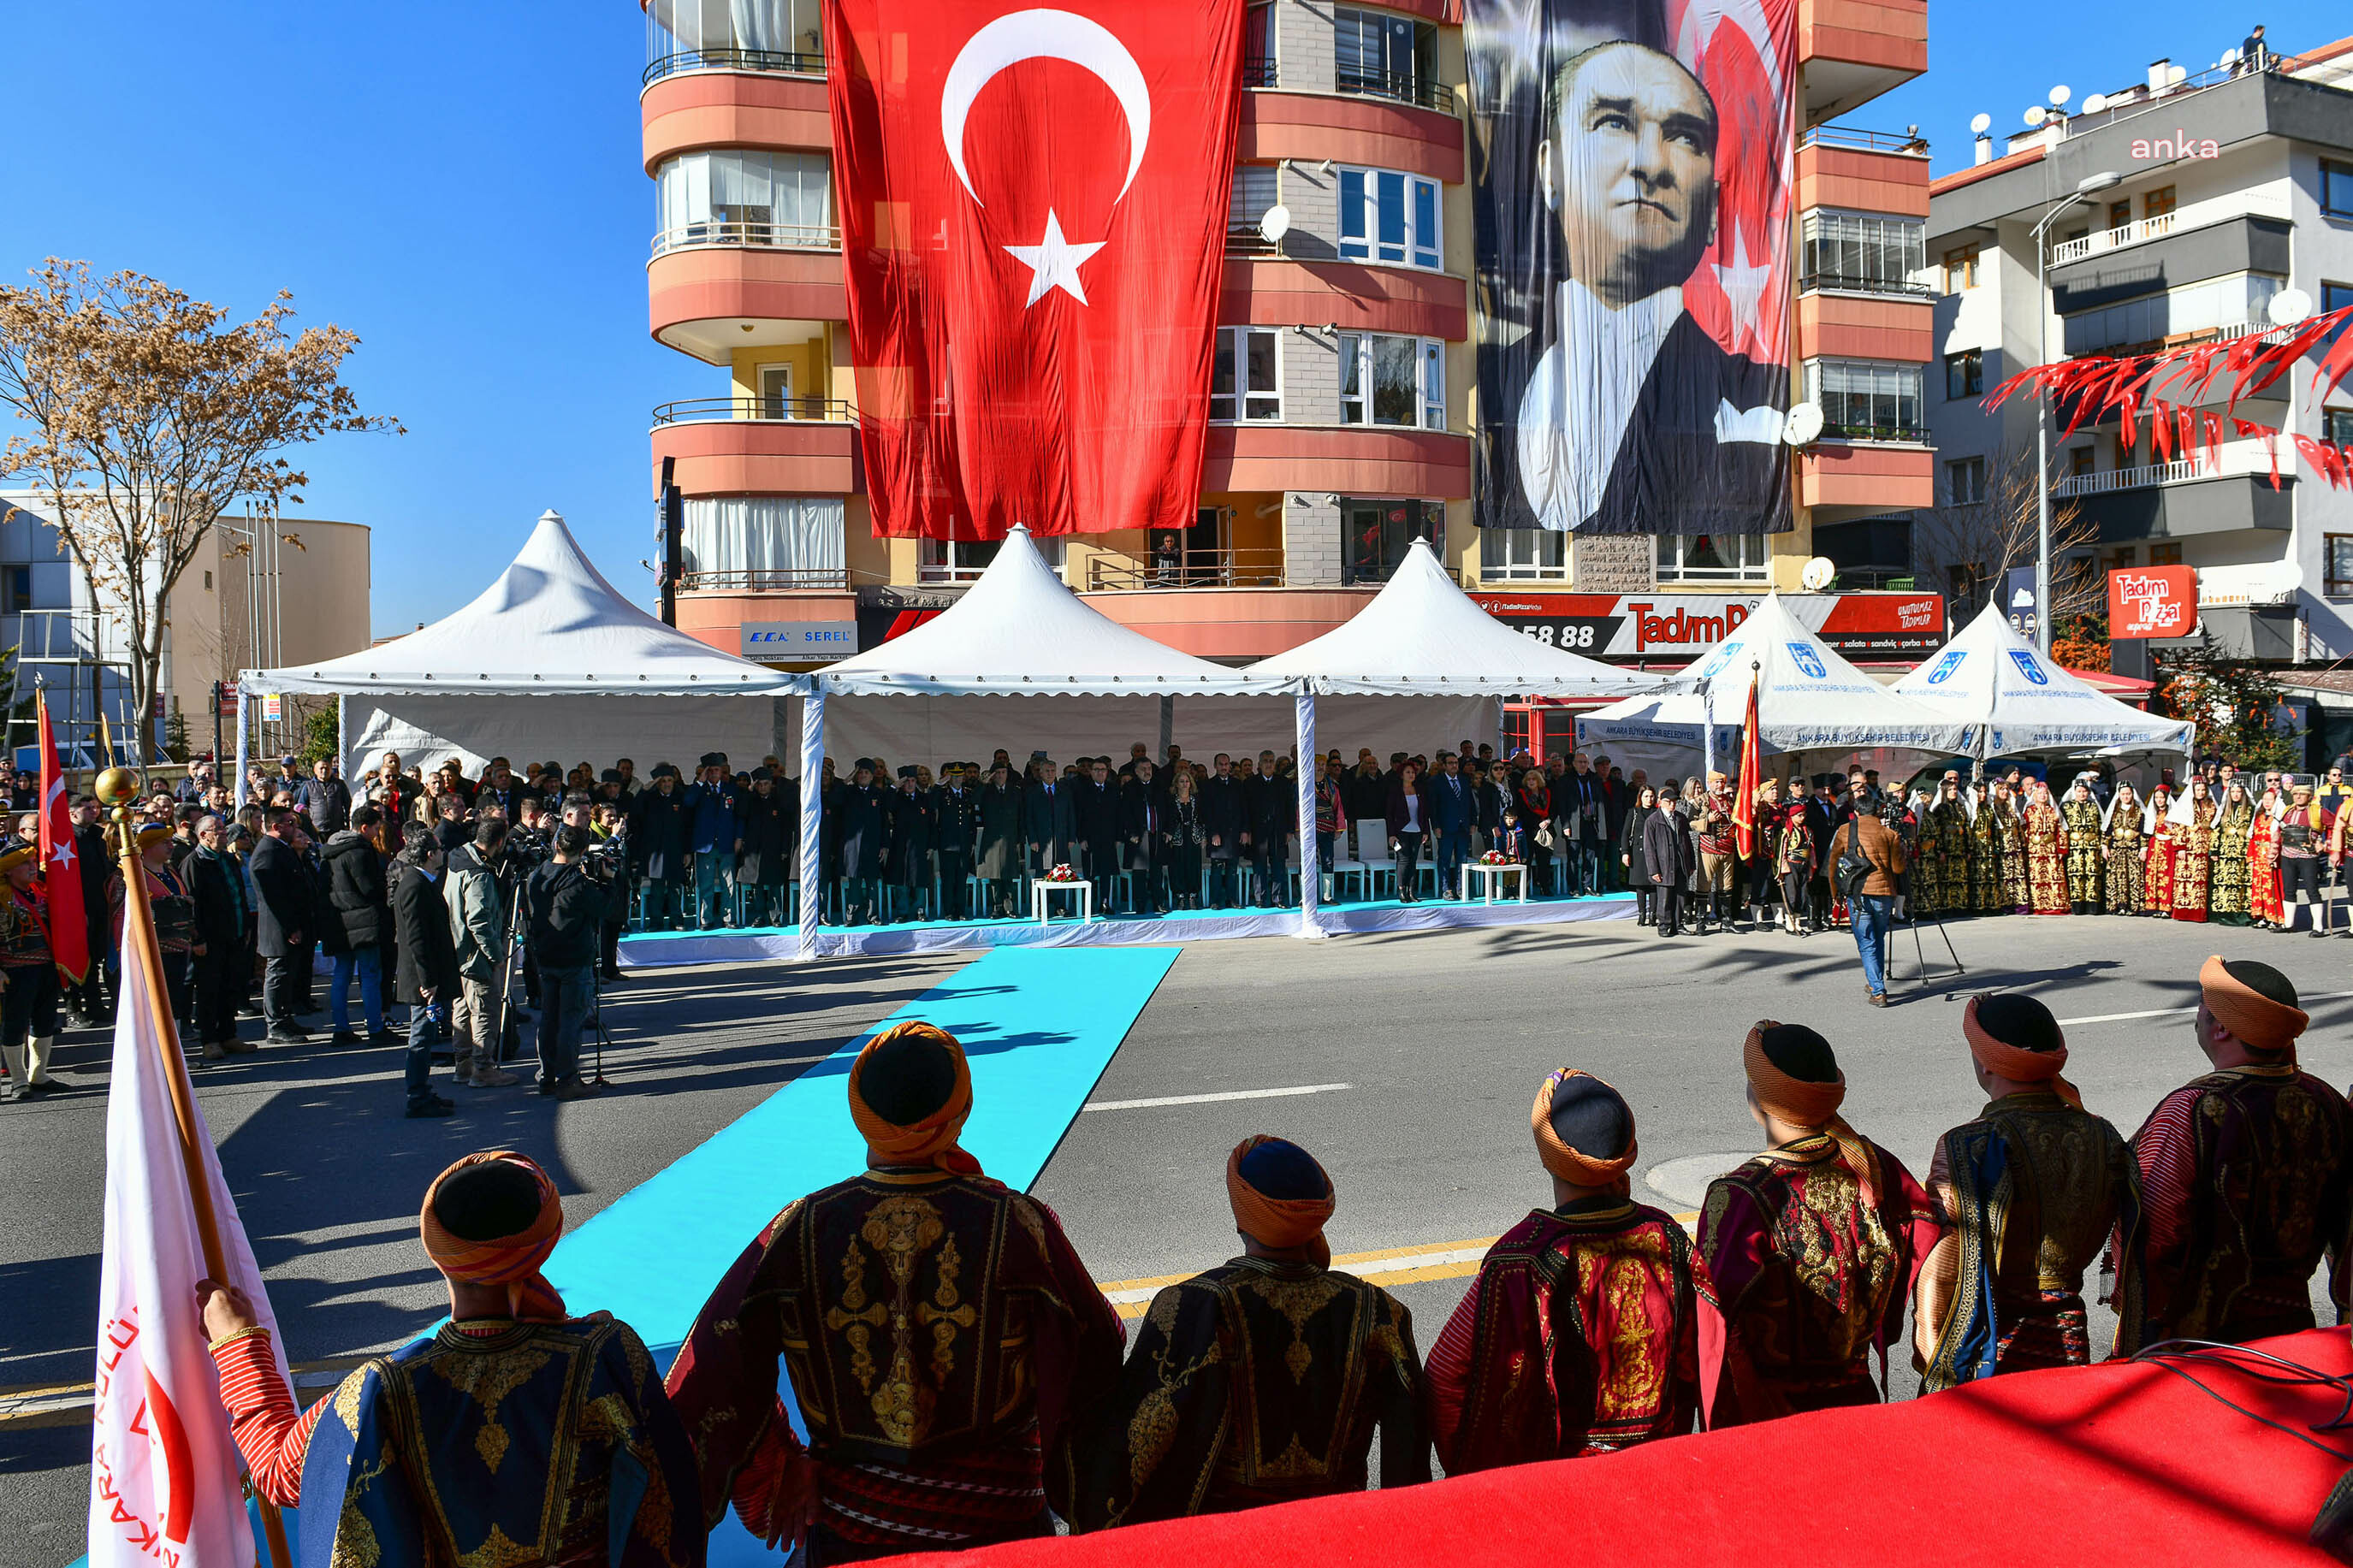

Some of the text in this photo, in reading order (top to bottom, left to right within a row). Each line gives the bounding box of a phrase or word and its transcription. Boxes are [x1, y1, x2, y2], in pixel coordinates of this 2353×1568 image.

[804, 631, 849, 642] SEREL
[1561, 625, 1595, 648] 88
[1844, 639, 1866, 648] salata
[1870, 638, 1897, 648] sandviç
[1901, 638, 1921, 648] çorba
[1605, 725, 1627, 735] ANKARA
[1797, 732, 1830, 742] ANKARA
[2033, 733, 2062, 742] ANKARA
